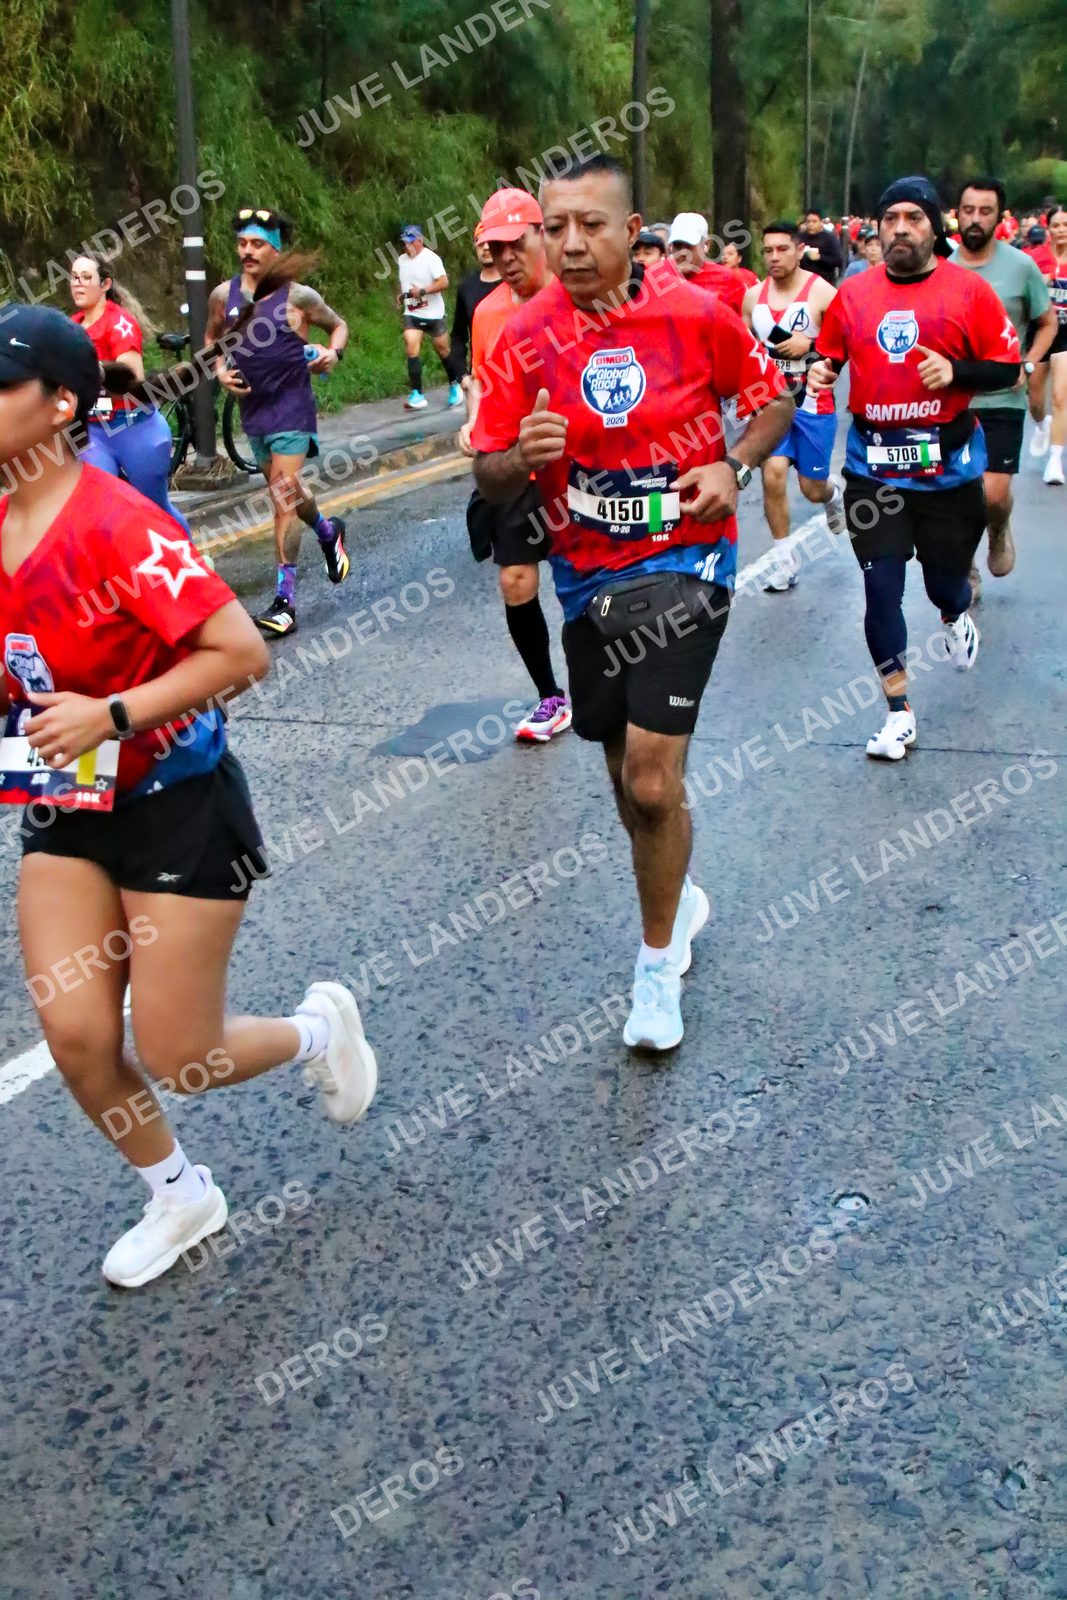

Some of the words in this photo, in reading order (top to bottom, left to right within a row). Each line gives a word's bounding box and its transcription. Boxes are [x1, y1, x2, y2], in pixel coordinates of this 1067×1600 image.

[596, 366, 630, 379] Global
[591, 379, 616, 391] Race
[865, 399, 941, 421] SANTIAGO
[605, 416, 625, 425] 2026
[887, 447, 918, 462] 5708
[597, 499, 643, 521] 4150
[652, 534, 669, 542] 10K
